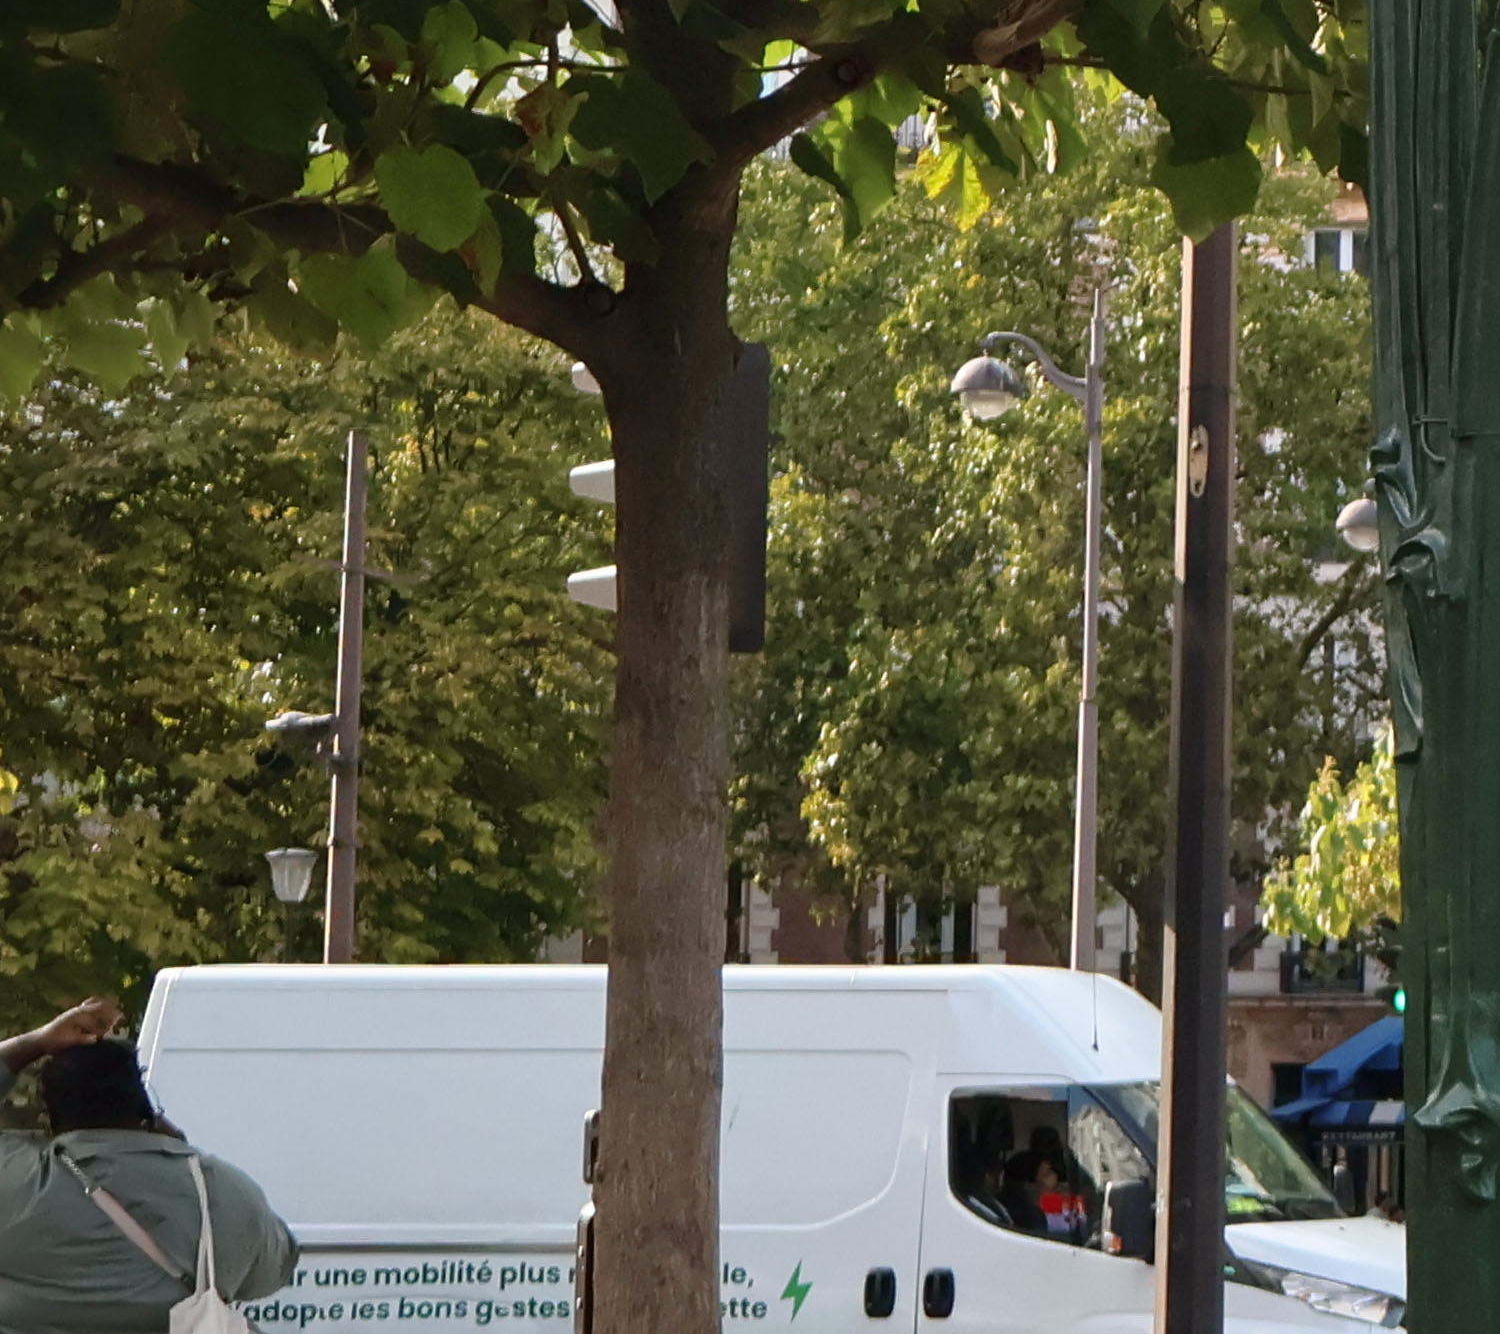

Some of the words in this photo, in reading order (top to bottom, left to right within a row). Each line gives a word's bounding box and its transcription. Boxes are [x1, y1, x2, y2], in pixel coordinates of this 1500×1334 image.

[315, 1266, 367, 1286] une
[374, 1260, 493, 1286] mobilité
[500, 1261, 561, 1290] plus
[398, 1297, 468, 1319] bons
